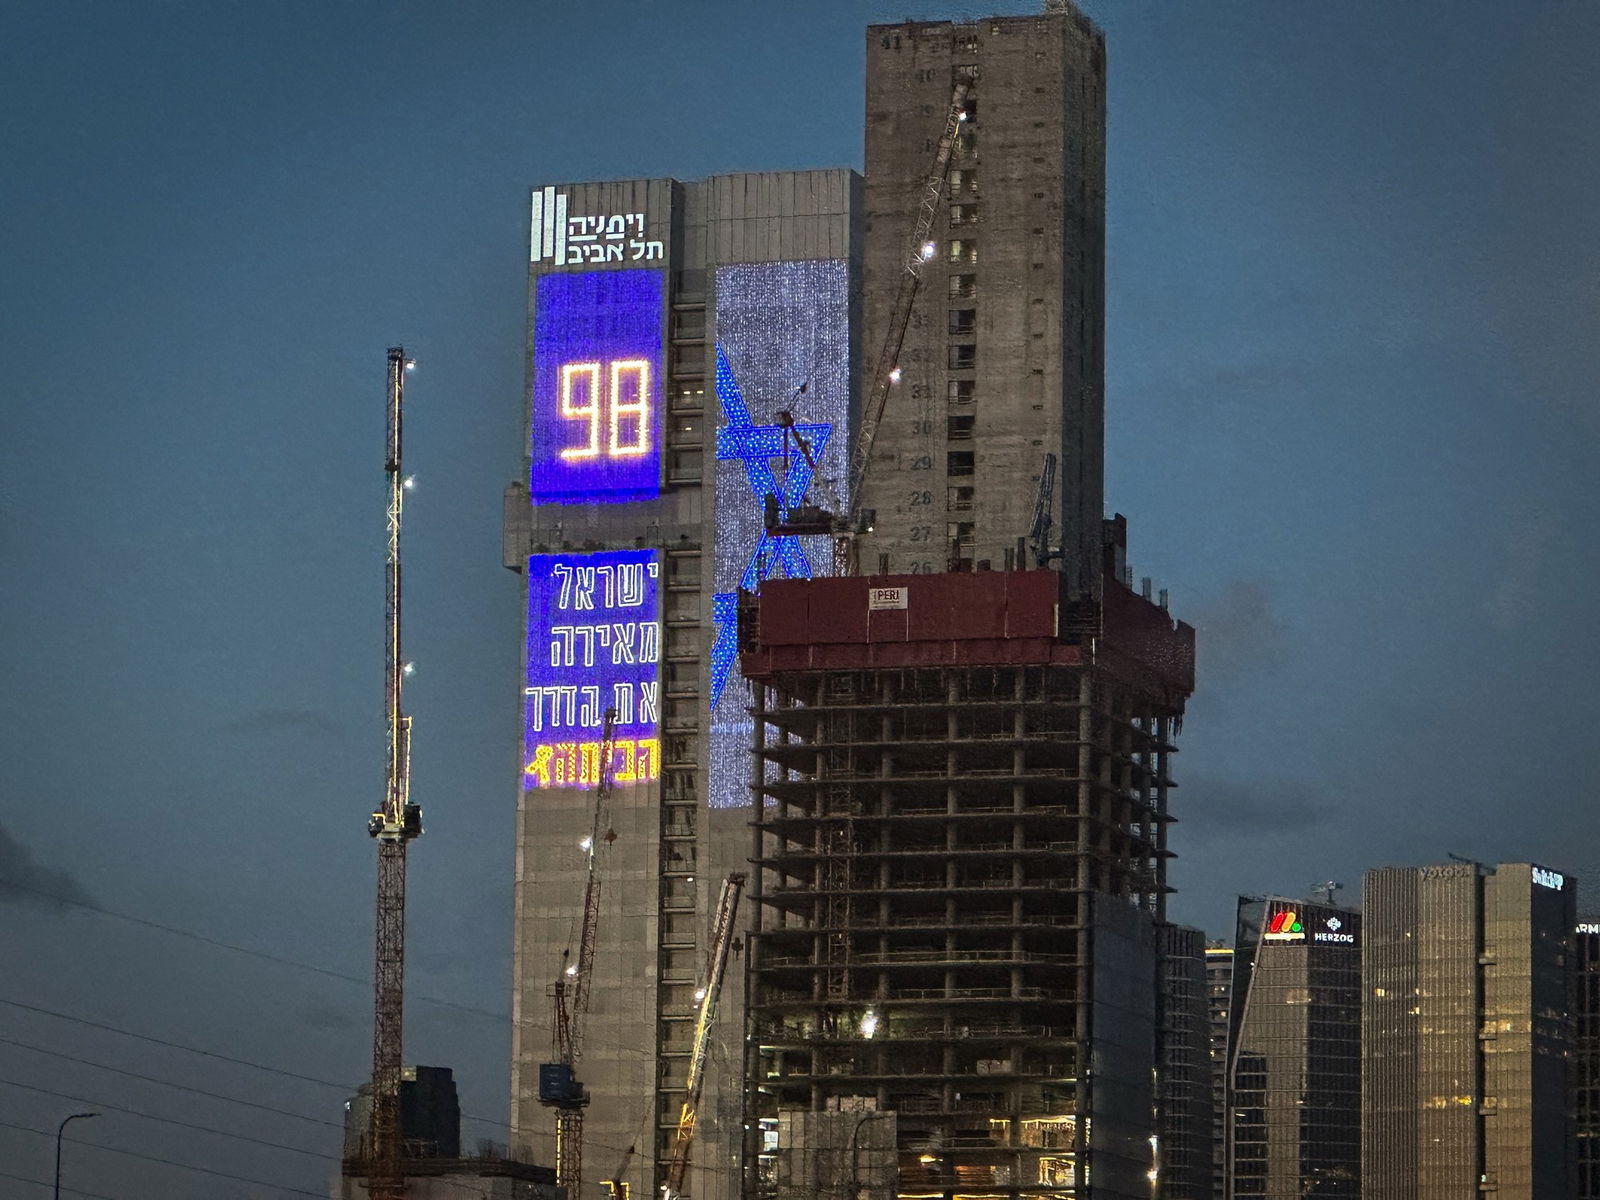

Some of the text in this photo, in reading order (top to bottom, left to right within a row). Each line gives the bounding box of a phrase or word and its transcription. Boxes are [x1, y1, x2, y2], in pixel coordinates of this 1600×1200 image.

[568, 213, 645, 241] ויתניה
[568, 238, 664, 264] תל אביב
[560, 359, 650, 460] 98
[910, 456, 931, 470] 29
[910, 491, 931, 506] 28
[910, 526, 931, 541] 27
[554, 563, 659, 610] ישראל
[877, 590, 900, 600] PERI
[551, 622, 659, 667] מאירה
[525, 682, 658, 731] את הדרך
[555, 738, 660, 783] הביתה
[1314, 932, 1355, 943] HERZOG
